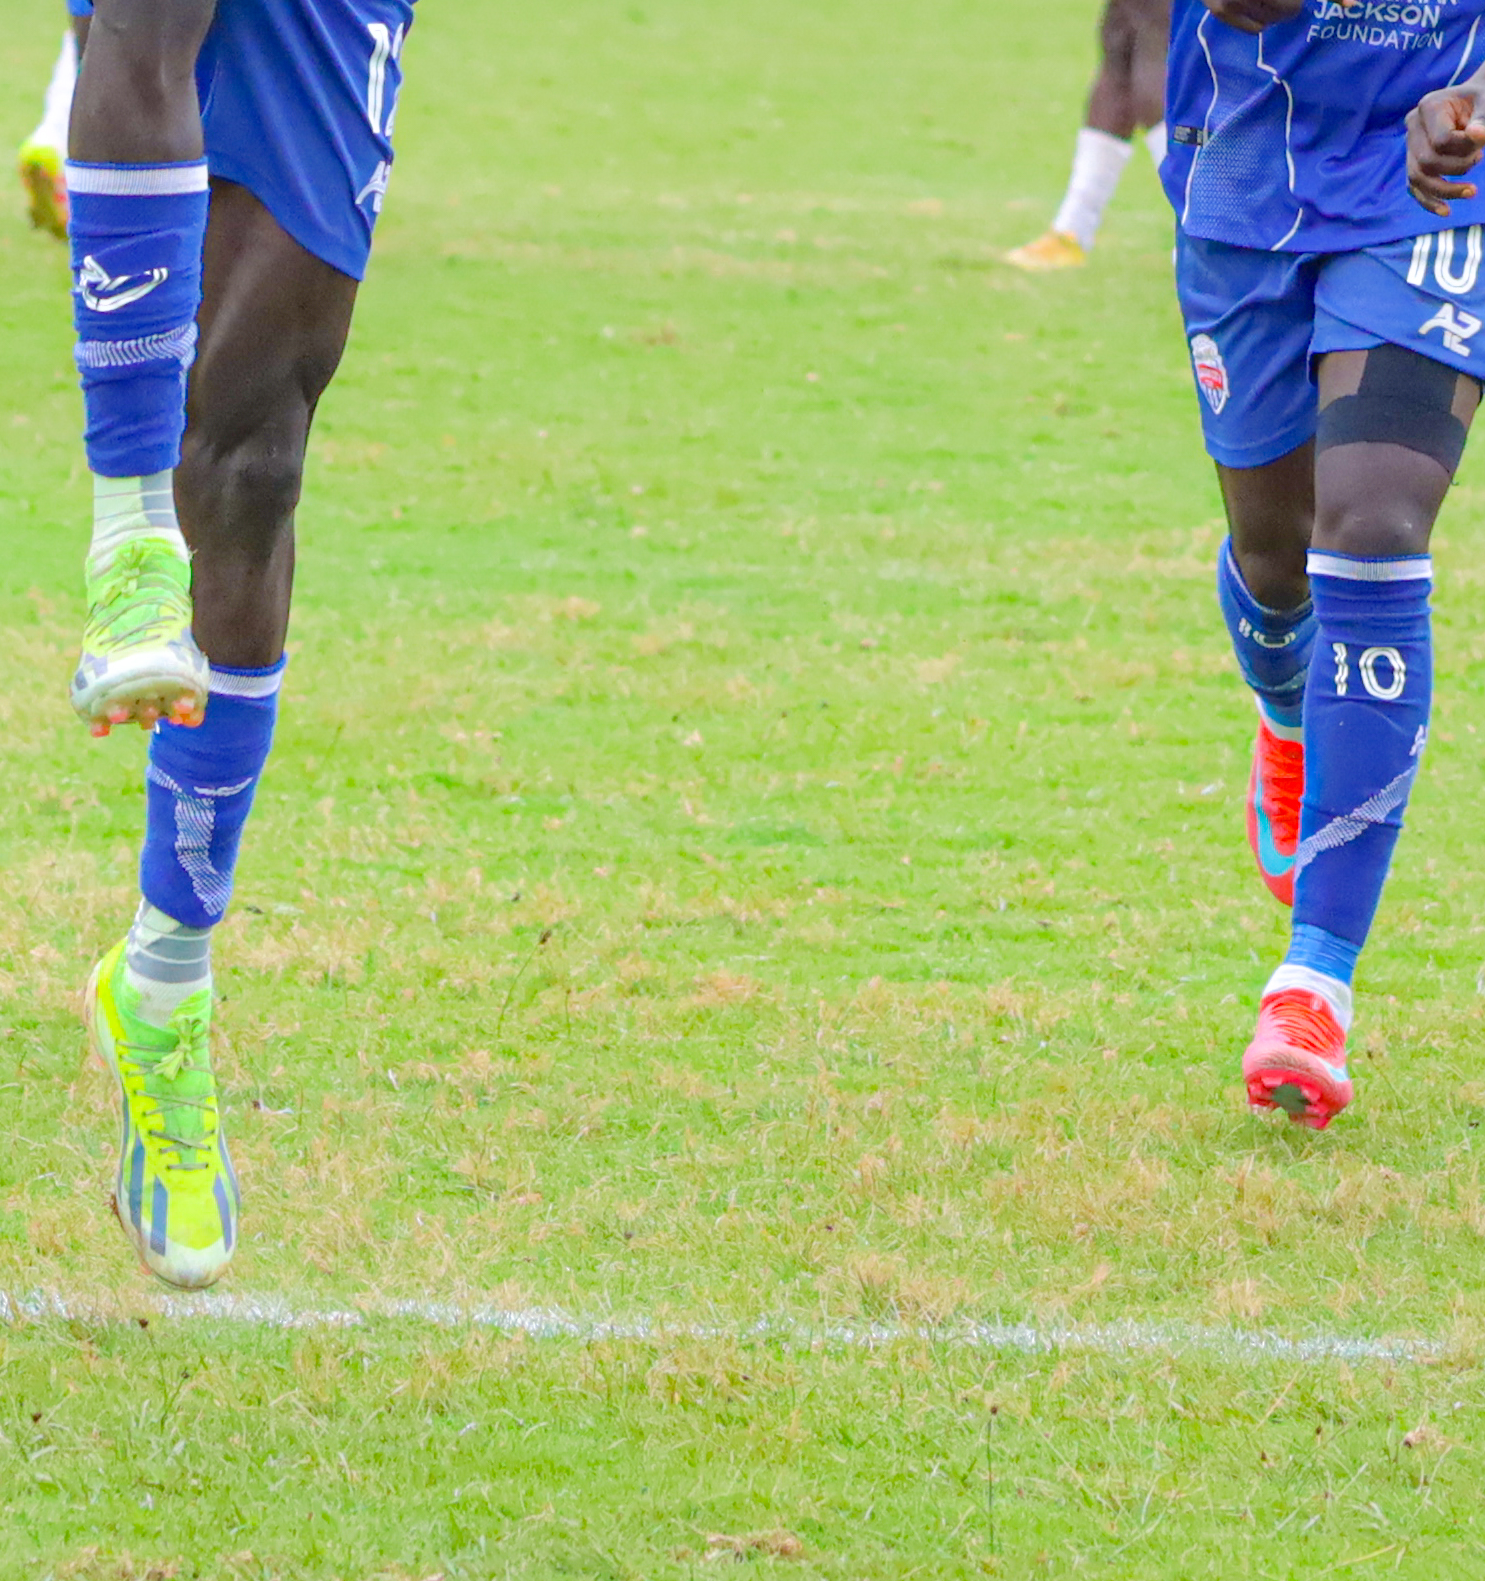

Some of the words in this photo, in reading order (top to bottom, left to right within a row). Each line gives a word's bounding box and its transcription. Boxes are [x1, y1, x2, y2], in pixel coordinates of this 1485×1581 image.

[1306, 23, 1444, 50] FOUNDATION
[1407, 225, 1482, 294] 10
[1332, 642, 1406, 701] 10
